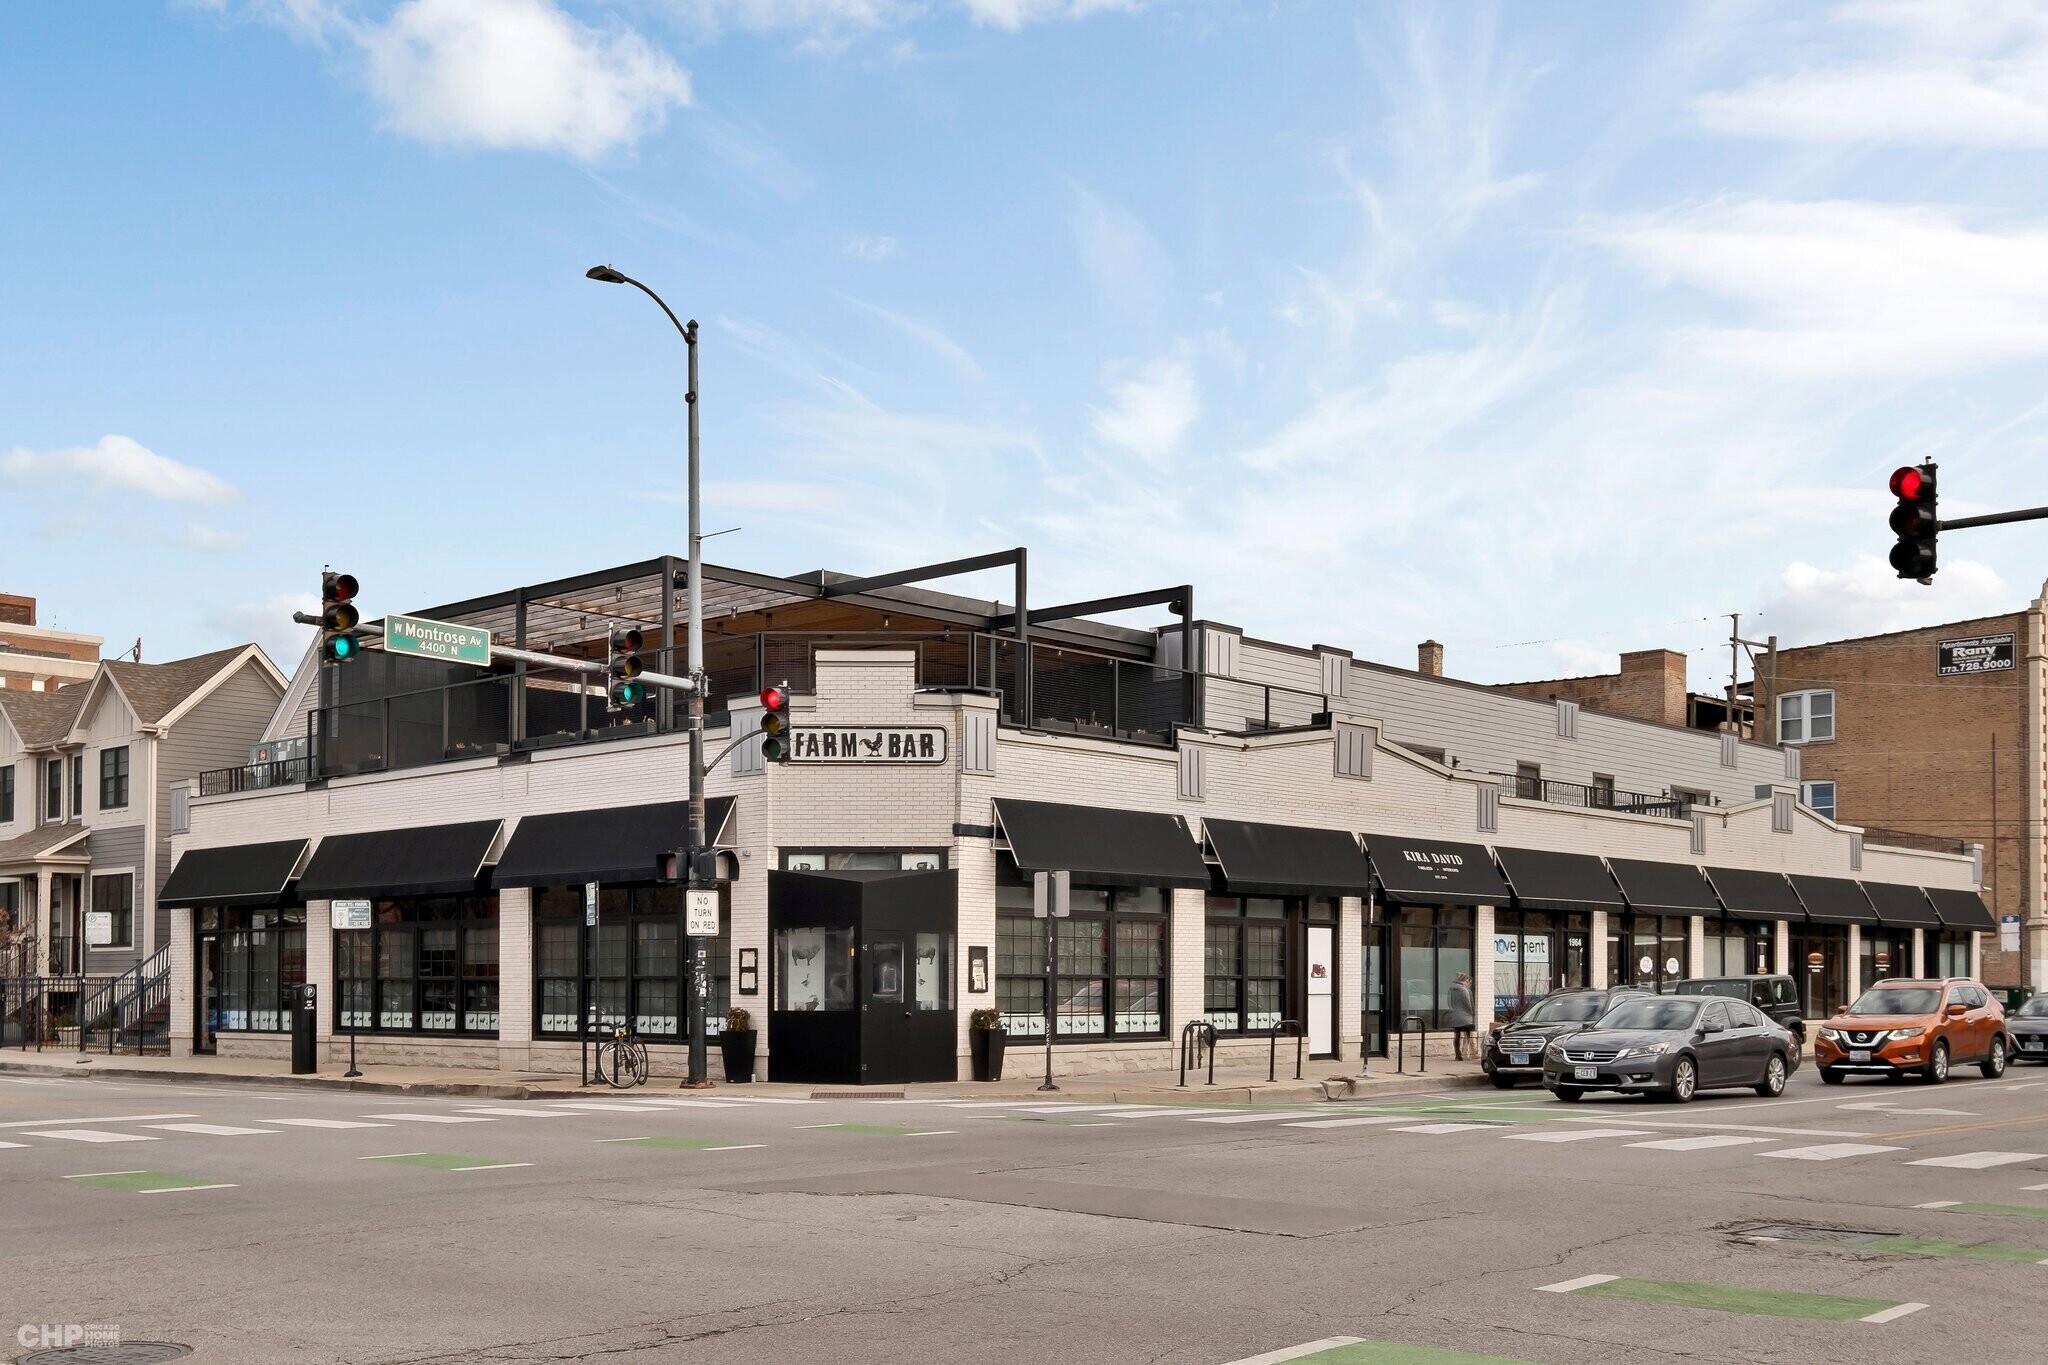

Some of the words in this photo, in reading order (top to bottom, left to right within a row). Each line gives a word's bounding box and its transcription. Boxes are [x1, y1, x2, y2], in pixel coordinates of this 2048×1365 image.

[394, 622, 402, 634] W
[405, 622, 466, 645] Montrose
[470, 636, 482, 648] Av
[419, 641, 446, 654] 4400
[450, 645, 459, 656] N
[1941, 639, 1980, 650] Apartments
[1980, 636, 2012, 645] Available
[1952, 646, 1997, 660] Rany
[1941, 659, 2012, 674] 773.728.9000
[795, 732, 858, 758] FARM
[888, 733, 935, 758] BAR
[1403, 850, 1431, 863] KIRA
[1430, 853, 1463, 865] DAVID
[697, 896, 708, 905] NO
[694, 908, 712, 917] TURN
[690, 920, 700, 929] ON
[702, 920, 716, 930] RED
[307, 988, 313, 996] P
